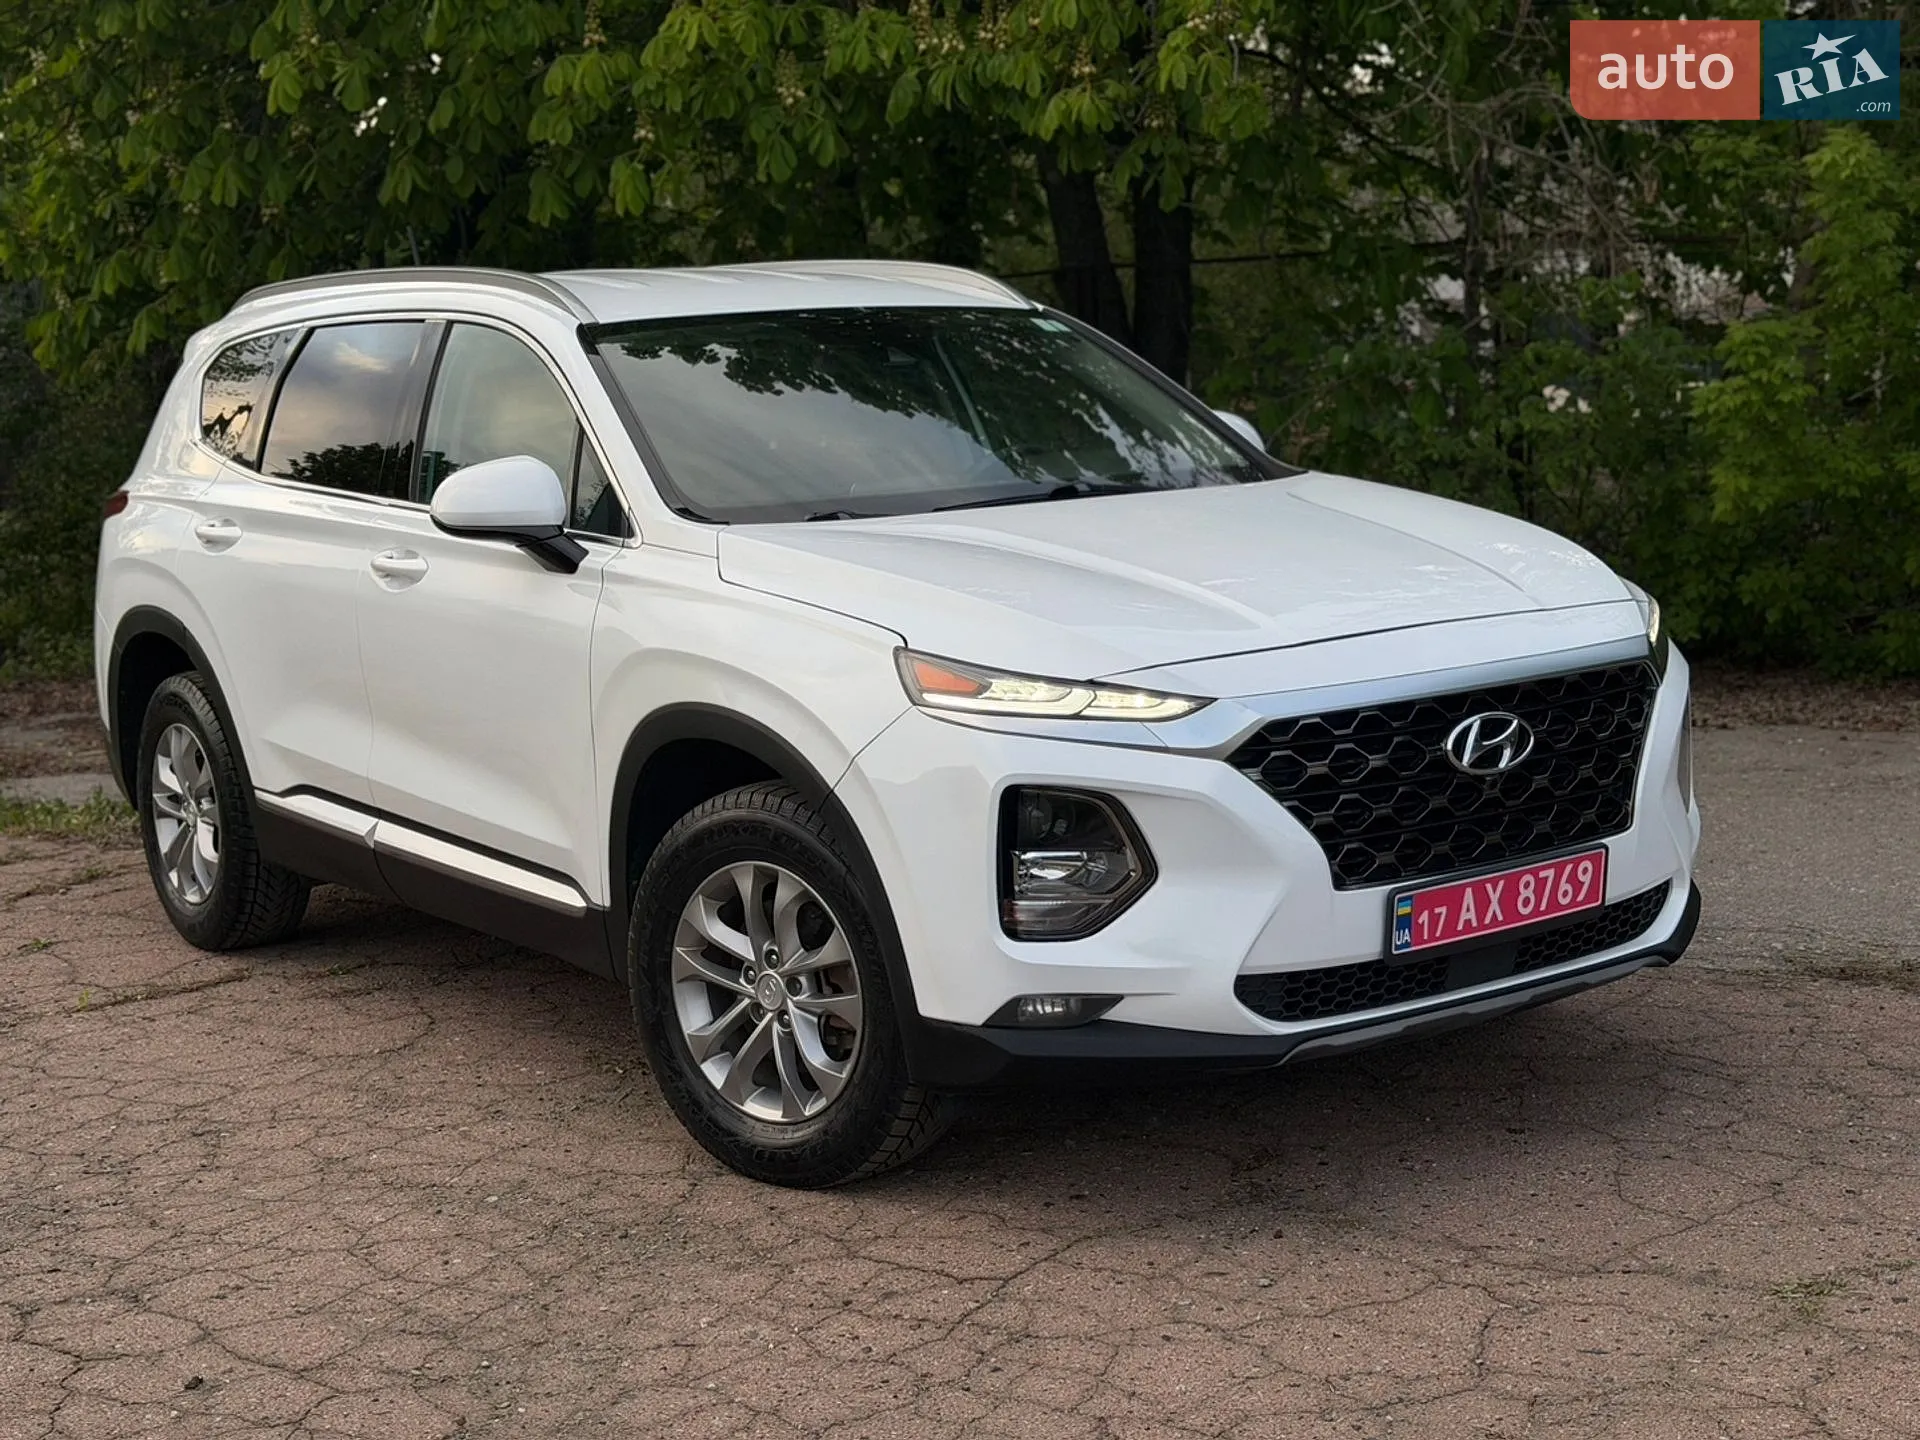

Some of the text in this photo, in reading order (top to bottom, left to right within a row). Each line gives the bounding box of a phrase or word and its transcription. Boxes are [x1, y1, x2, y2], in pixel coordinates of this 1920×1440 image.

[1417, 860, 1594, 940] 17 AX 8769
[1395, 931, 1411, 945] UA
